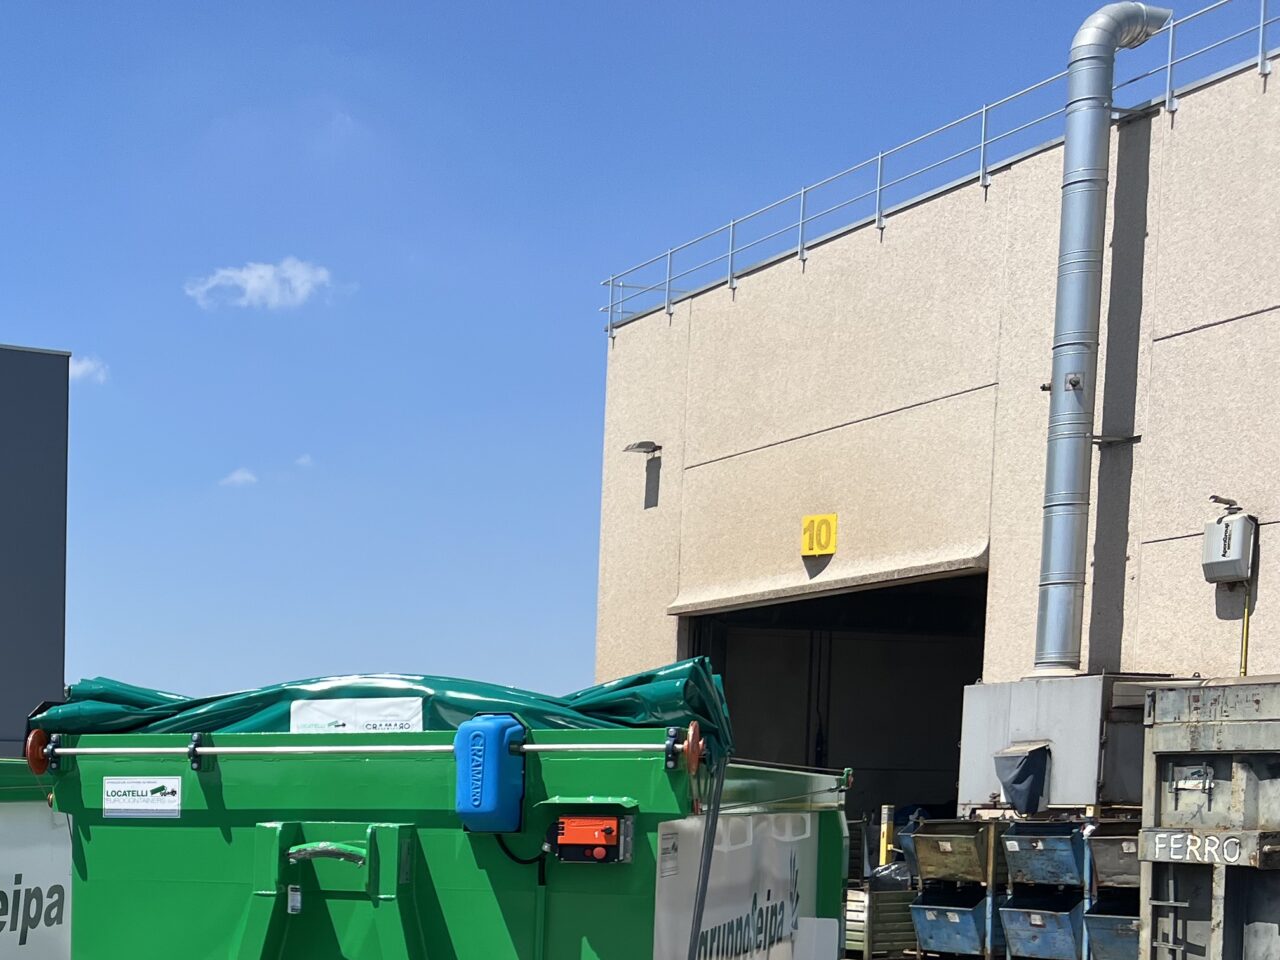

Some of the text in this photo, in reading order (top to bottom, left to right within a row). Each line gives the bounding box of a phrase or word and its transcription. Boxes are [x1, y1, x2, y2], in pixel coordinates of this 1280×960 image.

[803, 519, 831, 551] 10
[471, 731, 484, 807] CRAMARO
[1155, 834, 1239, 862] FERRO
